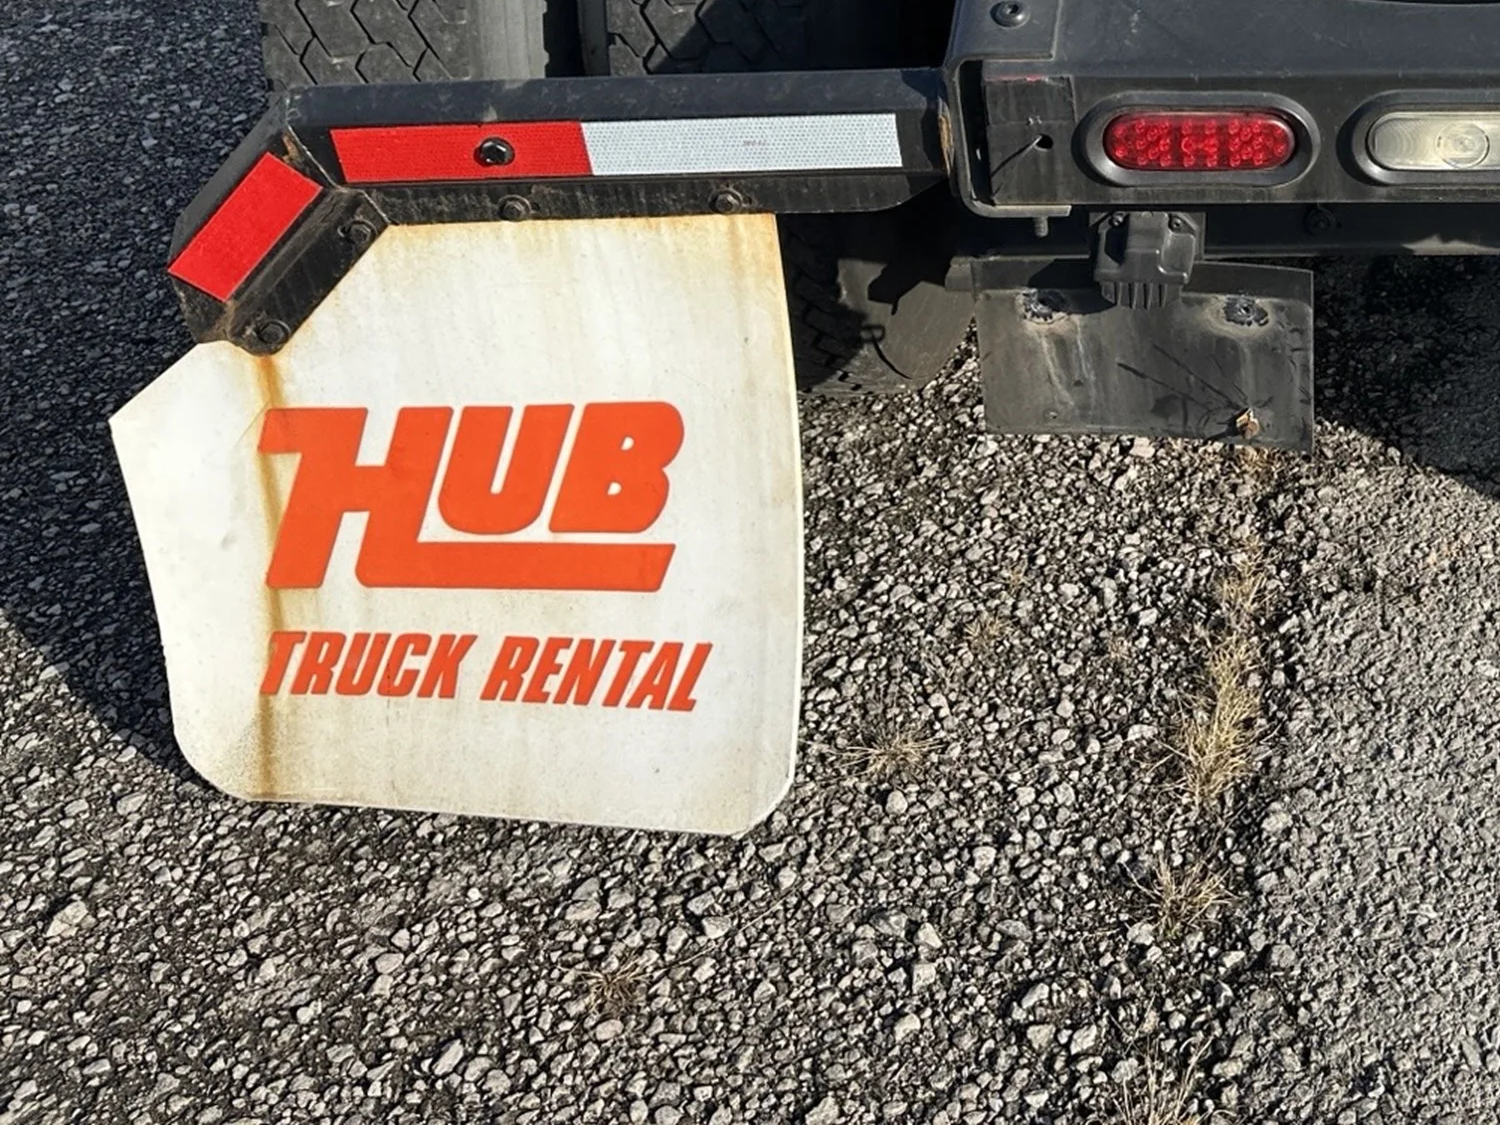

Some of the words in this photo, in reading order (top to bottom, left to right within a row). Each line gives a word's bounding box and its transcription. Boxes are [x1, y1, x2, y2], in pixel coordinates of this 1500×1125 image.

[258, 401, 685, 593] HUB
[259, 631, 478, 699] TRUCK
[480, 635, 713, 712] RENTAL
